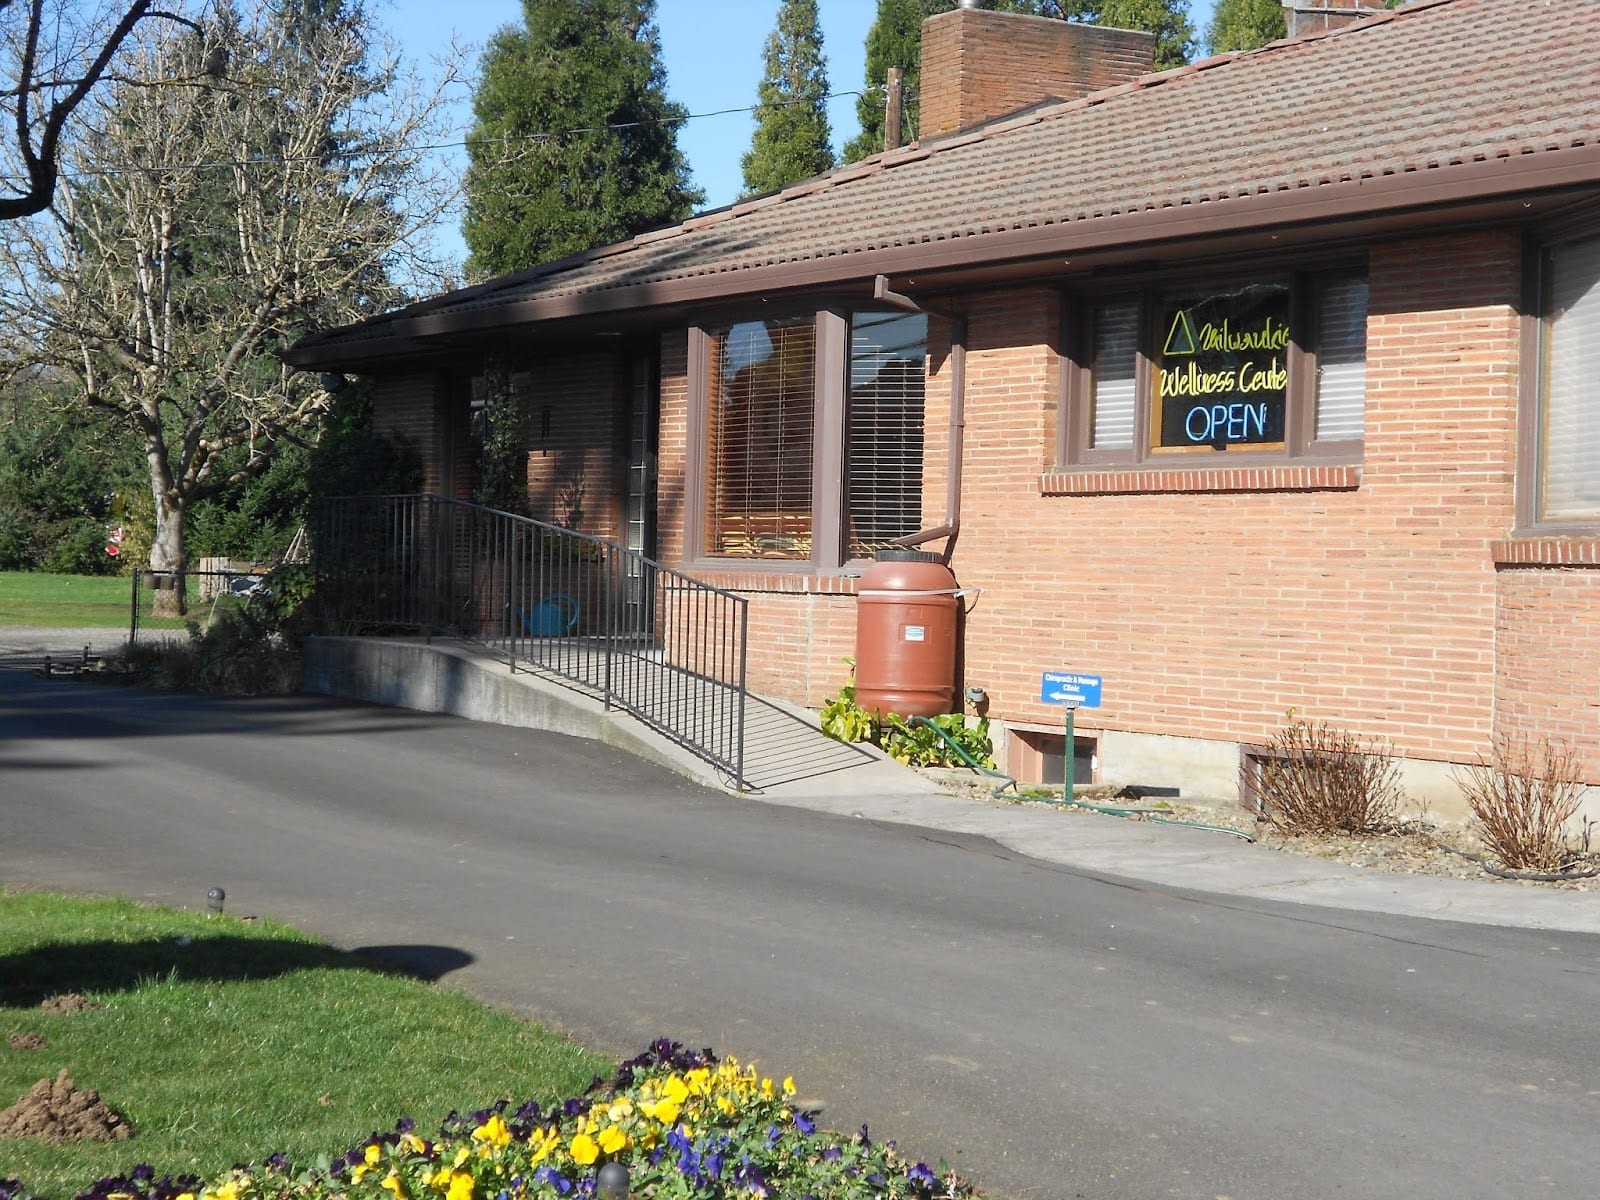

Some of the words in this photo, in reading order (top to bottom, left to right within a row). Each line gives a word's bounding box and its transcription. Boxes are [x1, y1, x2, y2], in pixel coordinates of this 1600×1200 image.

[1160, 360, 1236, 397] Wellness
[1239, 356, 1288, 393] Cente
[1185, 403, 1267, 442] OPEN
[1062, 684, 1081, 692] Clinic
